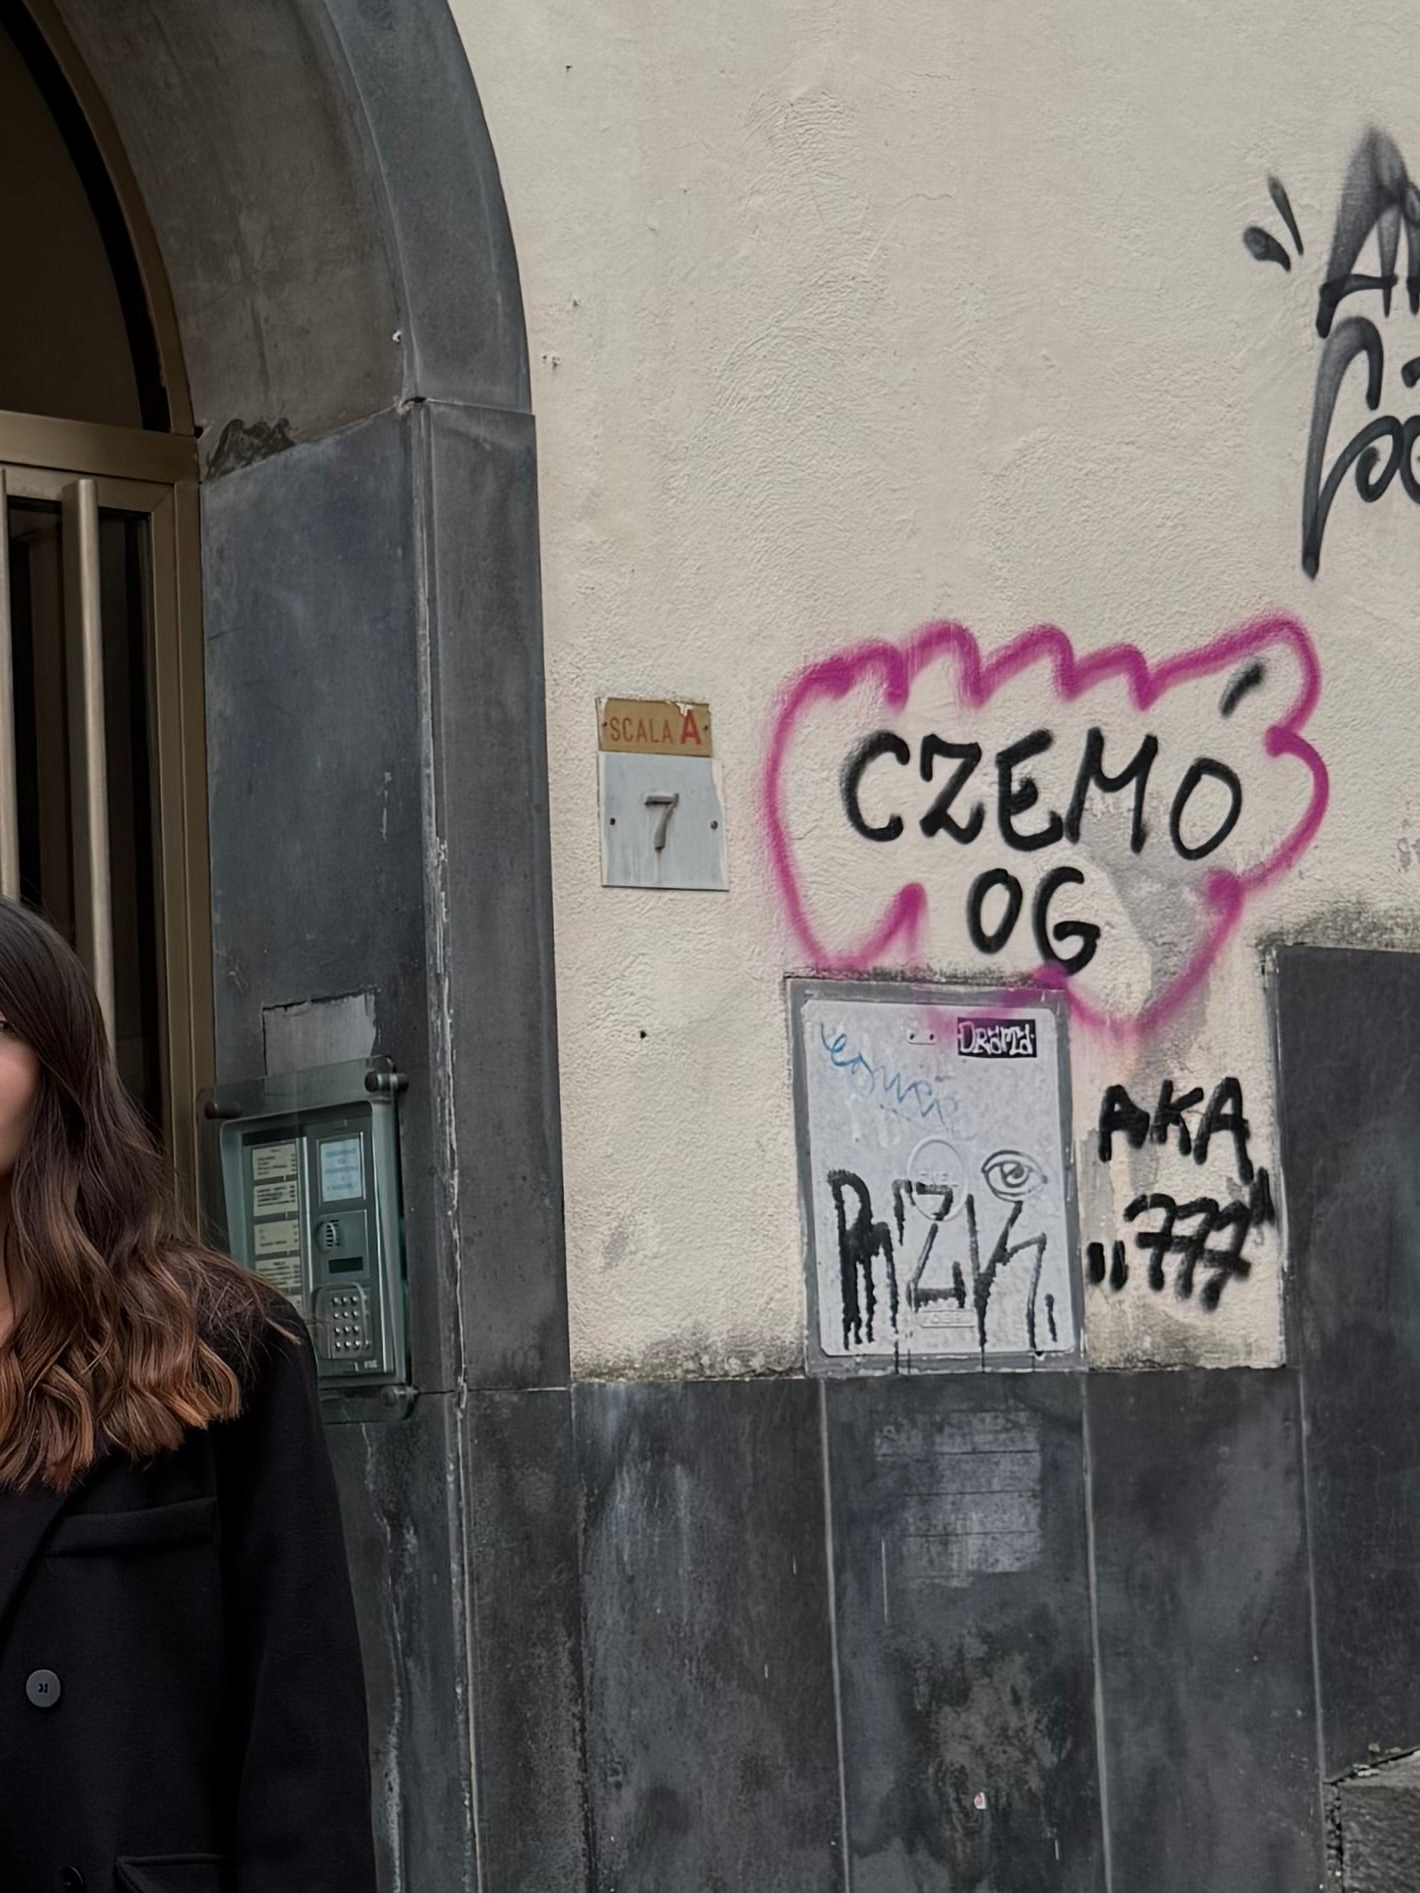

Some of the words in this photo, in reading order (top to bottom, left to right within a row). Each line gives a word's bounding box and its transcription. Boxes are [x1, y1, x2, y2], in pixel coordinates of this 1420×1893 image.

[609, 716, 674, 744] SCALA
[680, 708, 702, 746] A
[643, 792, 680, 851] 7
[966, 865, 1101, 977] OG
[1098, 1076, 1254, 1185] AKA
